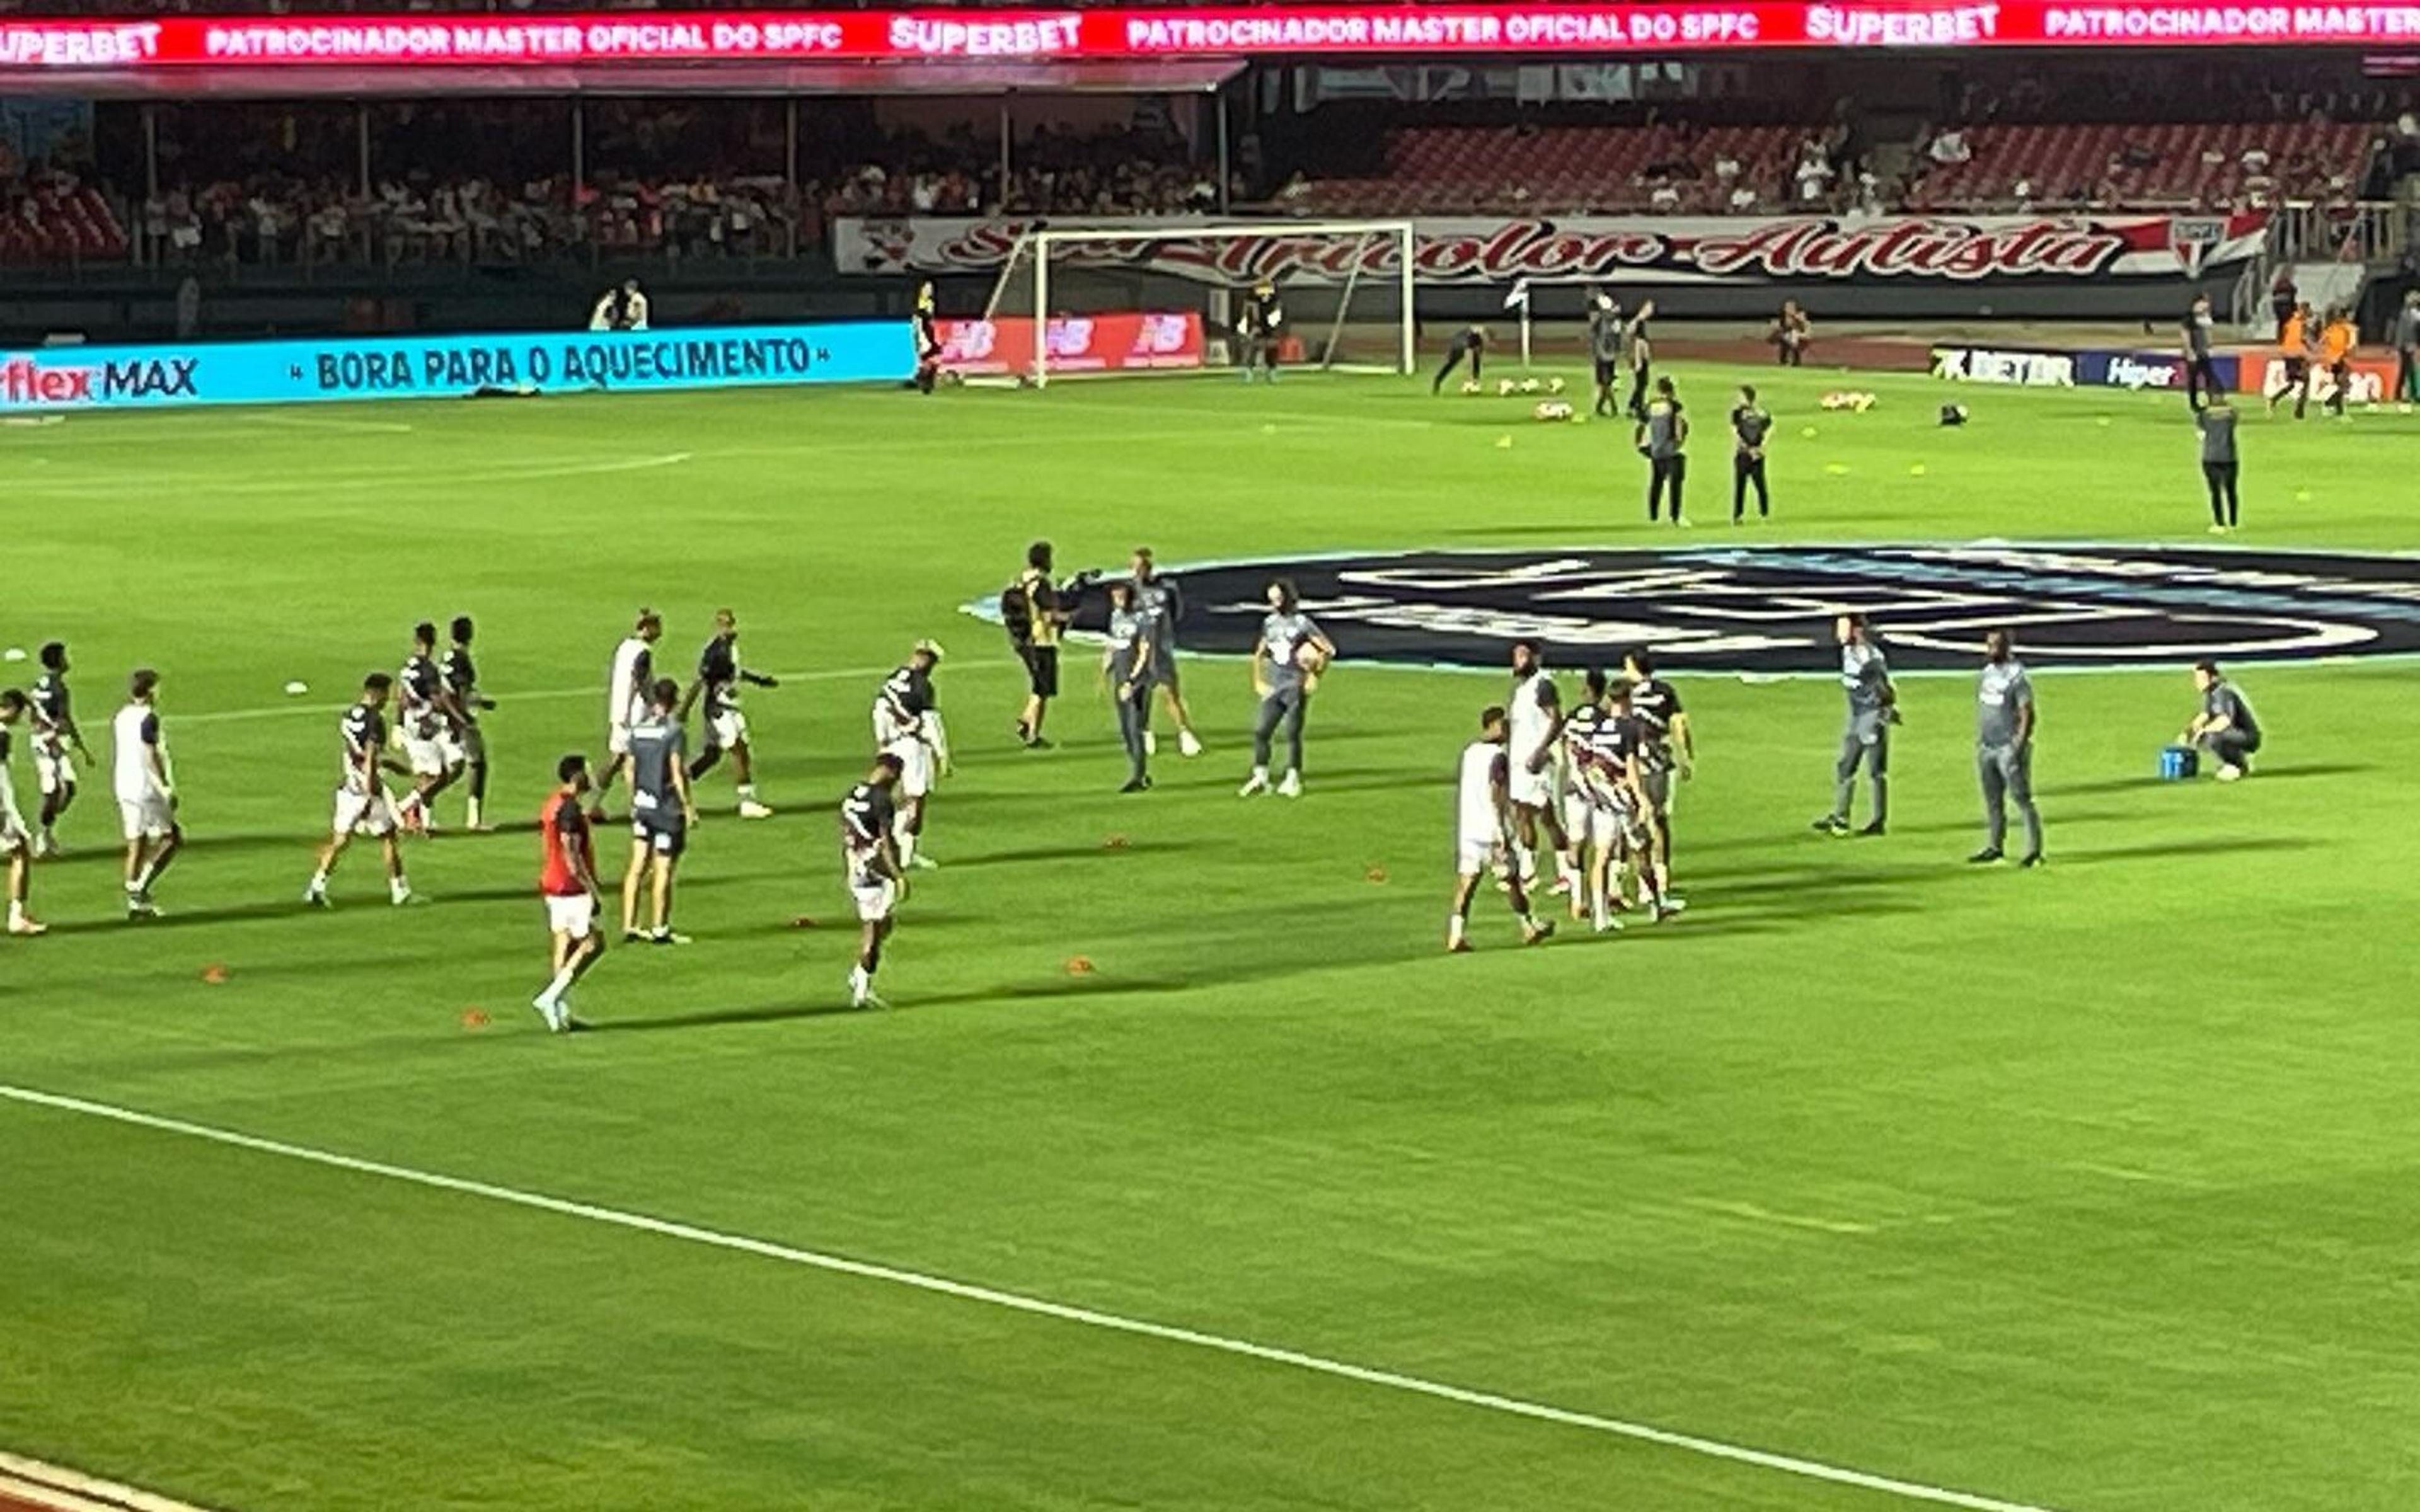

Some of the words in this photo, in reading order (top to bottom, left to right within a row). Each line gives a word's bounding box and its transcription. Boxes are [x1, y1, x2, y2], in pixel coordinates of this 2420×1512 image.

[206, 25, 451, 55] PATROCINADOR
[453, 25, 583, 55] MASTER
[587, 23, 707, 52] OFICIAL
[713, 22, 758, 50] DO
[763, 22, 843, 50] SPFC
[889, 13, 1082, 55] SUPERBET
[1126, 18, 1369, 48] PATROCINADOR
[1372, 16, 1501, 44] MASTER
[1506, 13, 1626, 43] OFICIAL
[1629, 13, 1676, 40] DO
[1681, 12, 1759, 40] SPFC
[1806, 4, 2000, 45] SUPERBET
[2044, 8, 2290, 37] PATROCINADOR
[2295, 6, 2420, 34] MASTER
[1694, 219, 2124, 277] Autista
[103, 358, 197, 399] MAX
[316, 351, 413, 389] BORA
[424, 347, 518, 386] PARA
[529, 346, 550, 383] O
[564, 337, 810, 389] AQUECIMENTO
